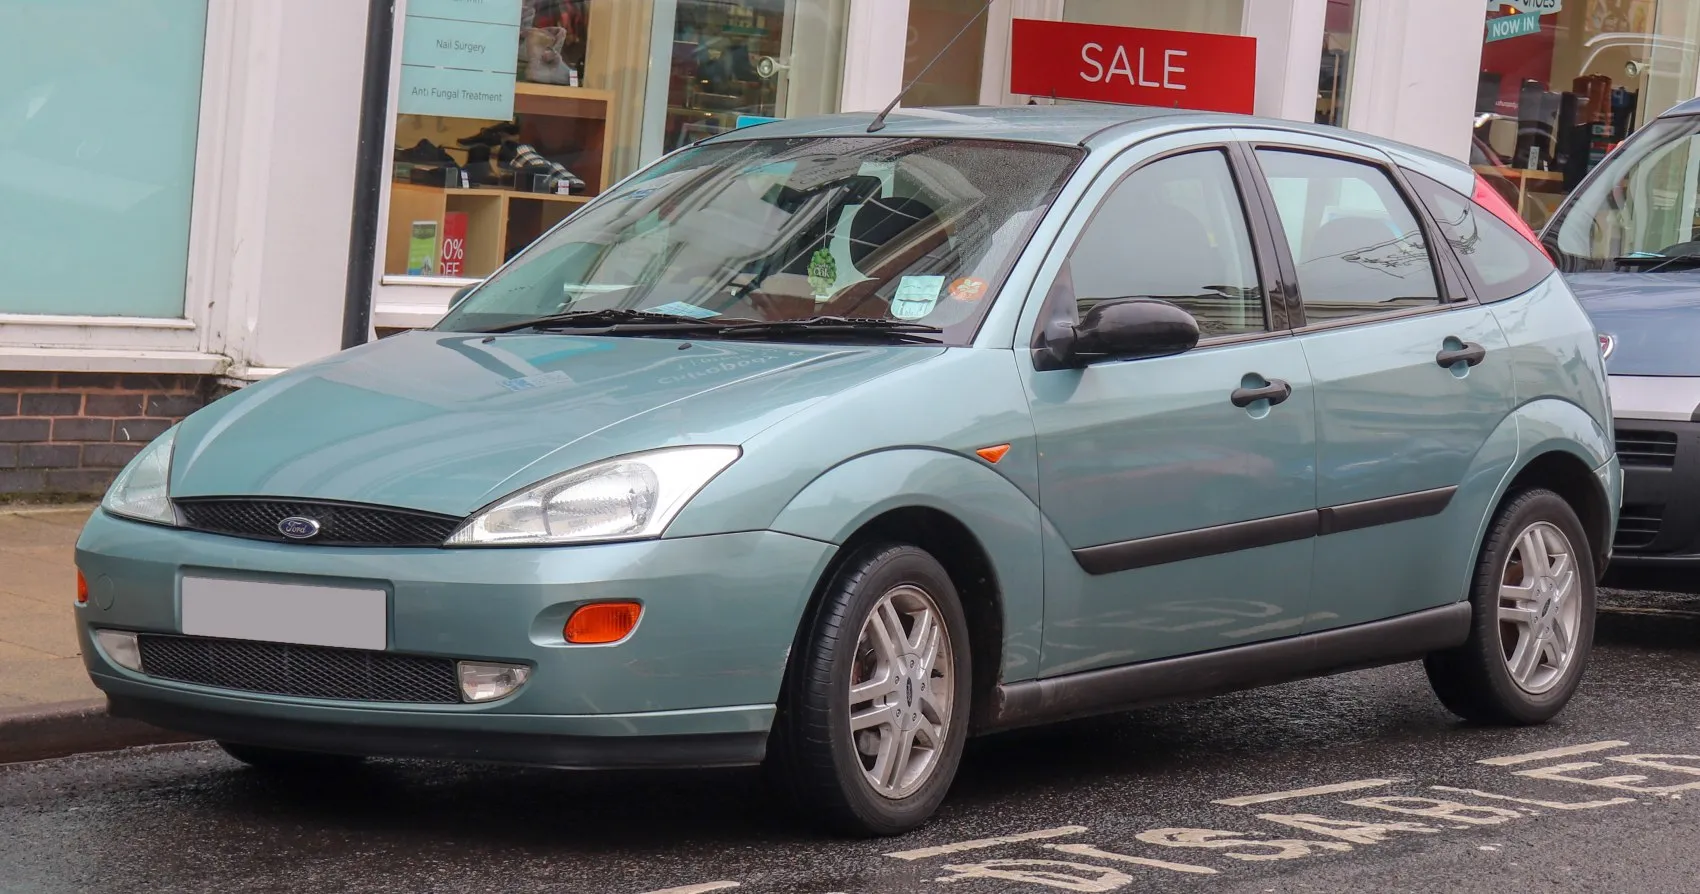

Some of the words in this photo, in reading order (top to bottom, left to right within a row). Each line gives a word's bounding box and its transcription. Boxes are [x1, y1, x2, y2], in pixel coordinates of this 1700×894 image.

[1493, 18, 1520, 37] NOW
[1523, 16, 1535, 31] IN
[436, 39, 452, 50] Nail
[454, 40, 486, 54] Surgery
[1079, 42, 1189, 91] SALE
[411, 86, 429, 97] Anti
[431, 87, 460, 101] Fungal
[462, 89, 503, 102] Treatment
[441, 238, 464, 260] 0%
[285, 521, 307, 533] Ford
[936, 753, 1700, 892] DISABLED
